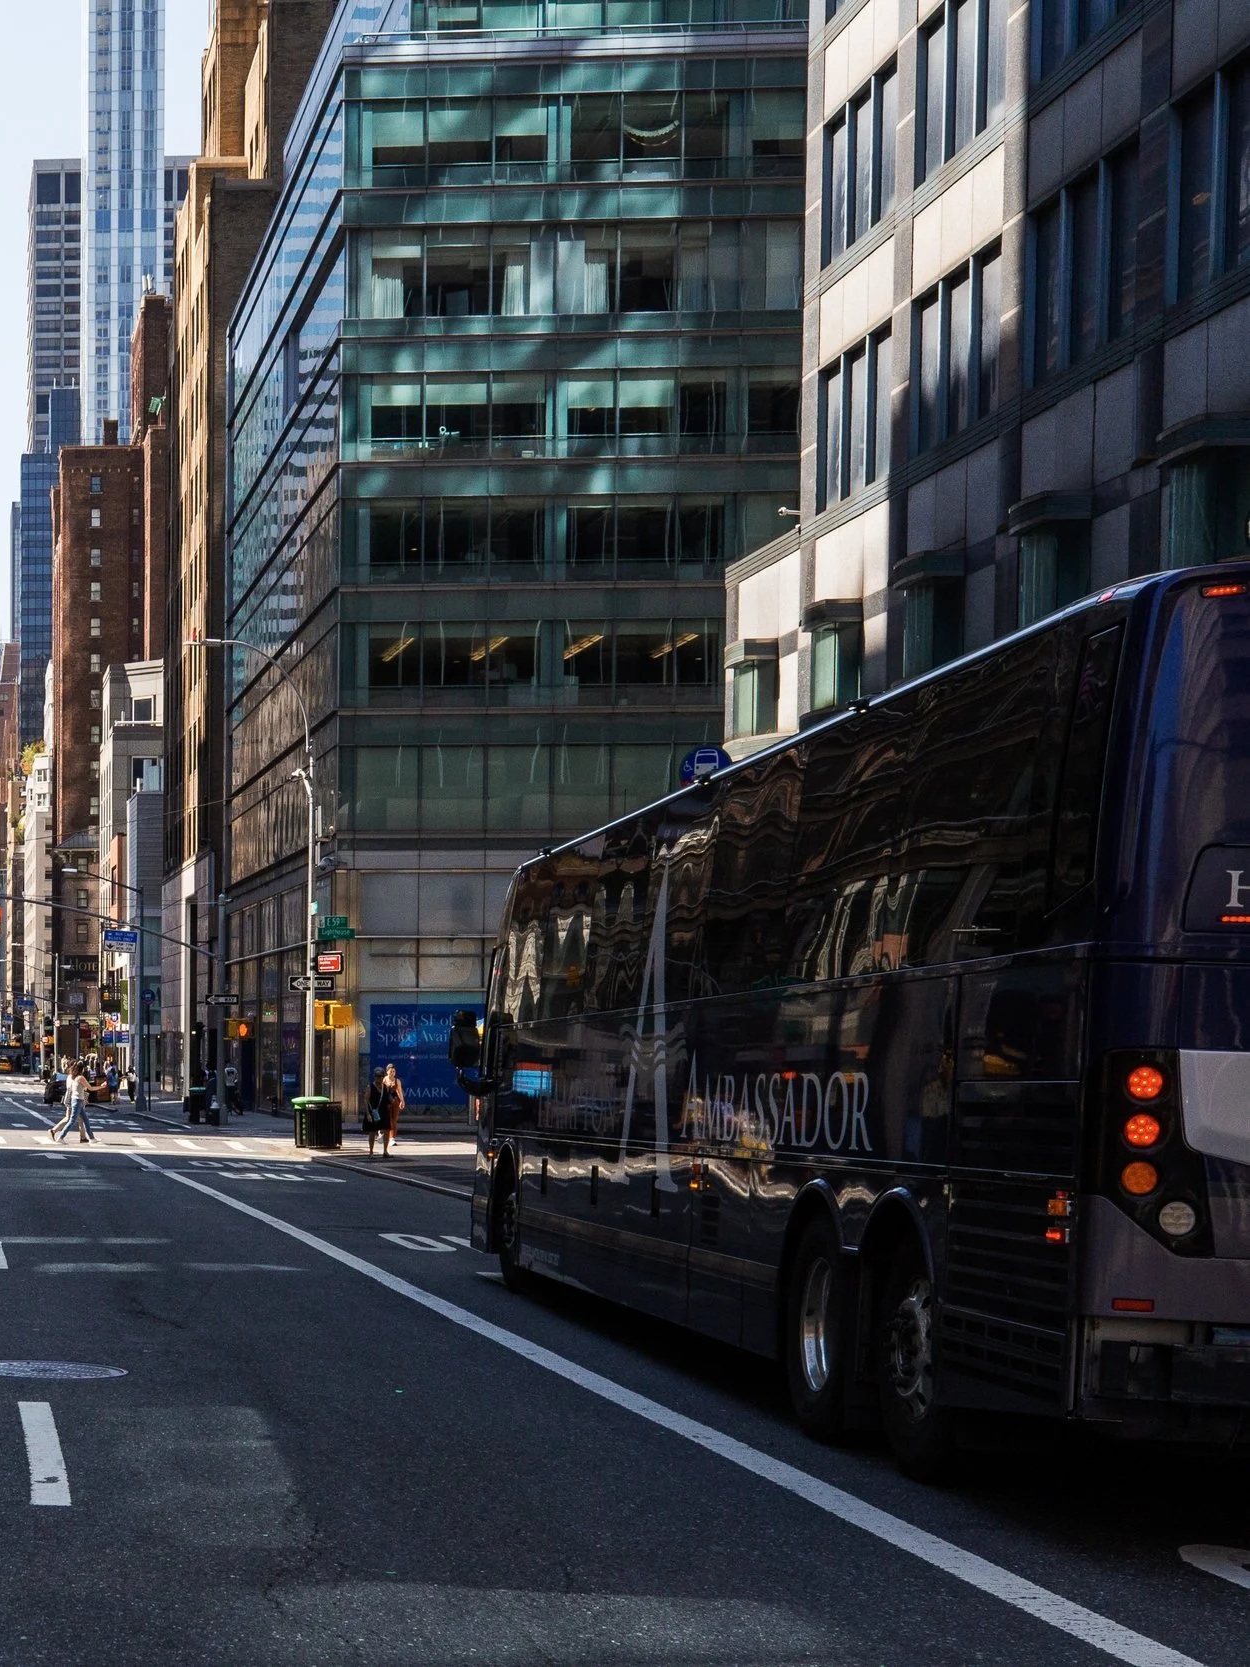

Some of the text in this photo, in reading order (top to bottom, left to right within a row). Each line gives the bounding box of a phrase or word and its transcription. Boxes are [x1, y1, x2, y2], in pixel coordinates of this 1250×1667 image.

[332, 917, 340, 926] 59
[321, 928, 350, 936] Lighthouse
[69, 958, 98, 972] HOTE
[420, 1014, 435, 1026] SF
[680, 1050, 873, 1151] AMBASSADOR
